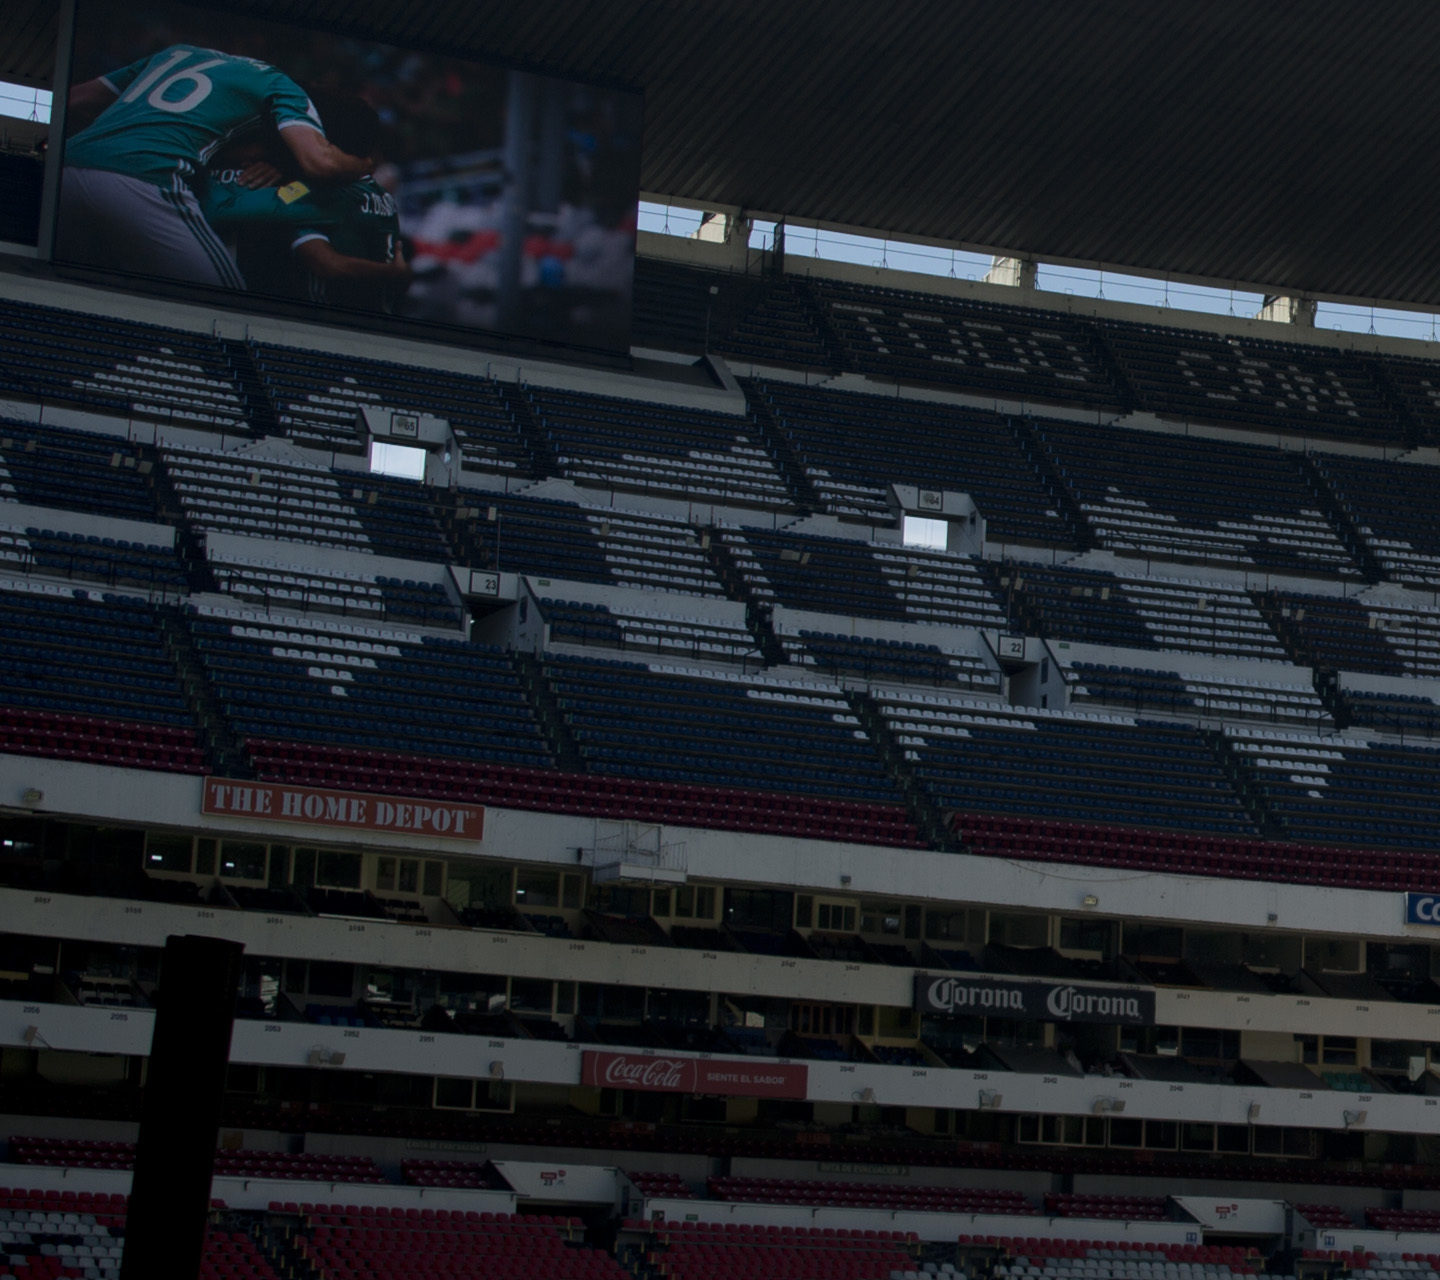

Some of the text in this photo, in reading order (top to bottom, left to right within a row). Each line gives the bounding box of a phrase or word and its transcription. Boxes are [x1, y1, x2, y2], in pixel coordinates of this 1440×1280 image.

[124, 50, 228, 113] 16
[485, 579, 496, 590] 23
[1011, 642, 1022, 653] 22
[211, 783, 471, 834] THE HOME DEPOT
[927, 977, 1142, 1021] Corona Corona
[605, 1055, 785, 1089] Coca-Cola SIENTE EL SABOR
